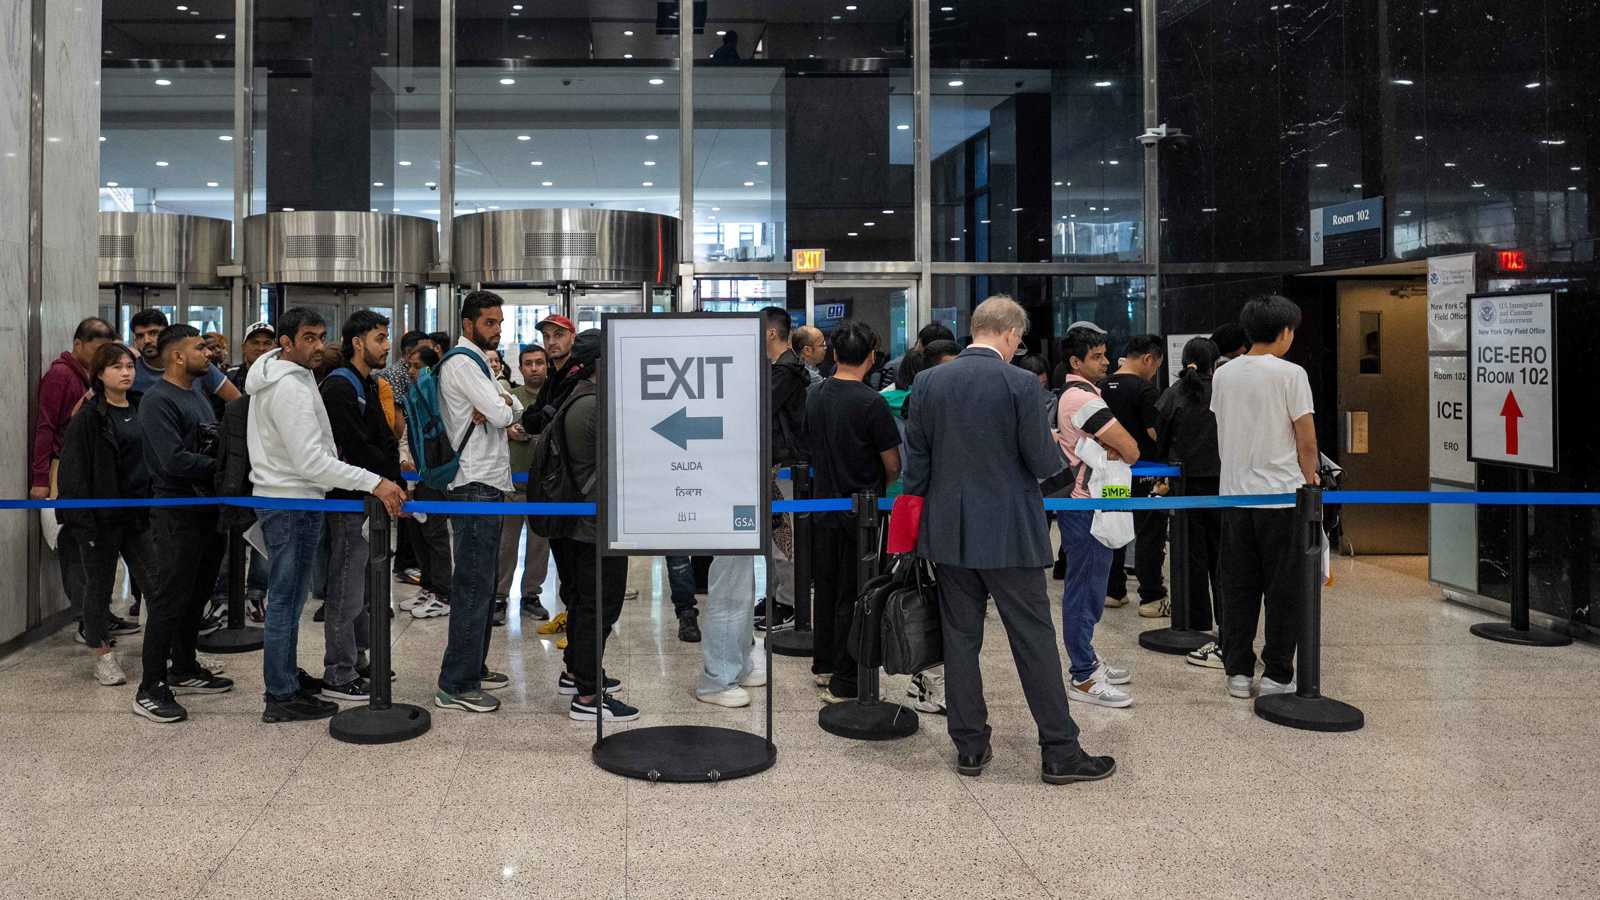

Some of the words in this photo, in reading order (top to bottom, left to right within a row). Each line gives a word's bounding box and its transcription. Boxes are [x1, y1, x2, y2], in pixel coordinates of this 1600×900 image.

[1332, 214, 1354, 226] Room
[1356, 209, 1370, 222] 102
[796, 250, 822, 270] EXIT
[1431, 303, 1443, 311] New
[1445, 302, 1458, 311] York
[1434, 312, 1449, 321] Field
[1503, 328, 1513, 336] City
[1529, 327, 1546, 335] Office
[1478, 346, 1547, 364] ICE-ERO
[640, 356, 733, 400] EXIT
[1433, 371, 1453, 380] Room
[1455, 371, 1467, 381] 102
[1520, 367, 1548, 385] 102
[1437, 400, 1463, 420] ICE
[1443, 441, 1459, 452] ERO
[670, 461, 703, 472] SALIDA
[678, 511, 696, 522] 出口
[734, 517, 755, 528] GSA
